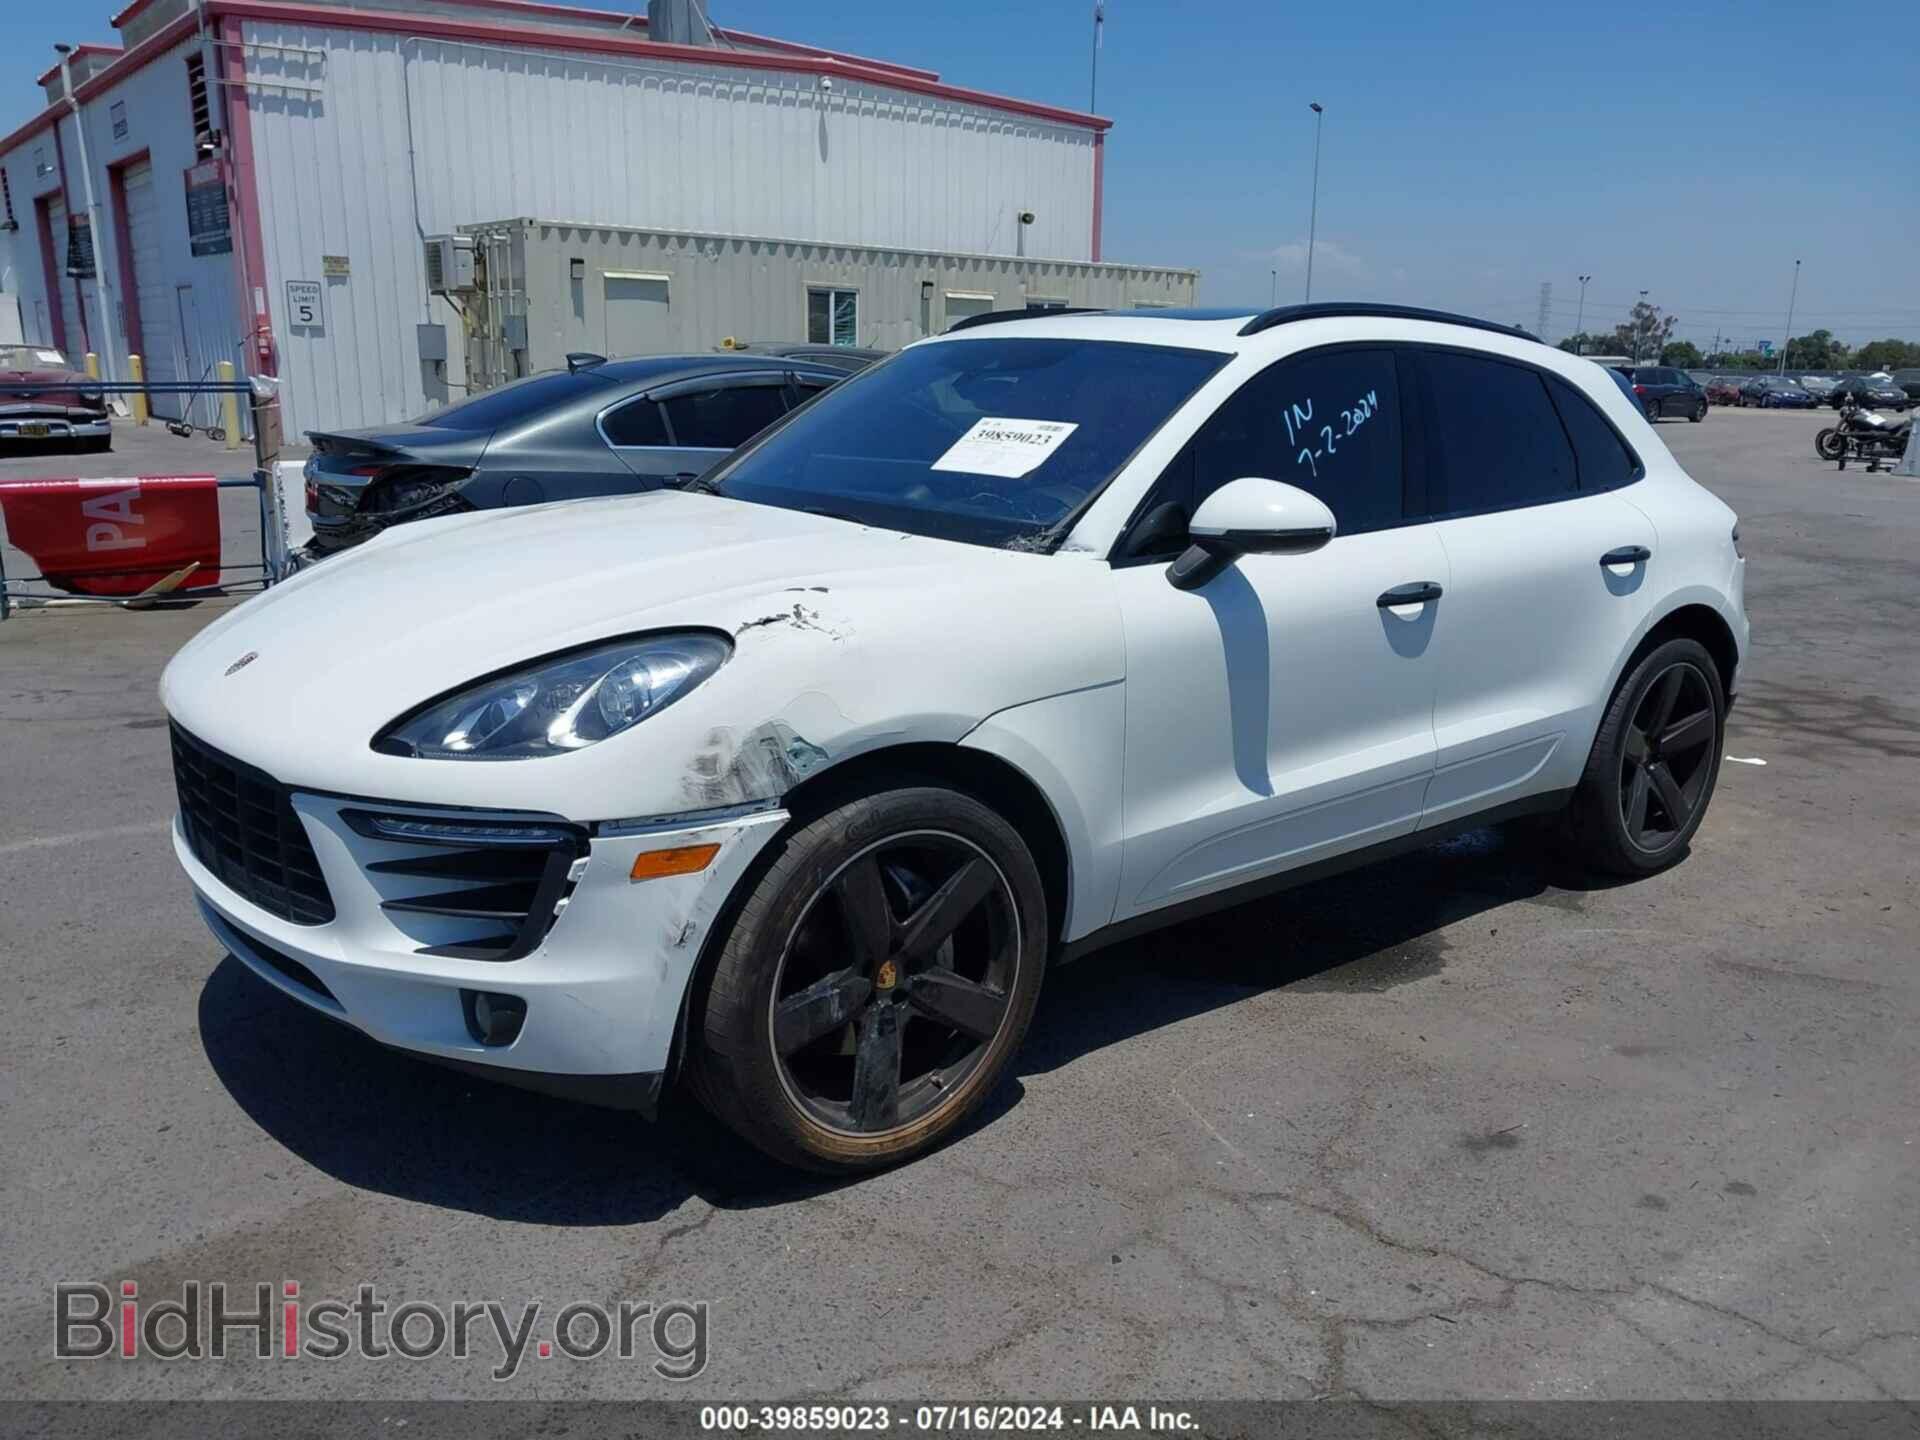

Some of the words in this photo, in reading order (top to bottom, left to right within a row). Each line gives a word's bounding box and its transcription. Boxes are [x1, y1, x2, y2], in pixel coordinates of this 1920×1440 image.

[288, 285, 318, 294] SPEED
[293, 295, 316, 303] LIMIT
[300, 306, 313, 322] 5
[1283, 398, 1313, 447] IN
[976, 428, 1053, 446] 39859023
[81, 487, 147, 552] PA
